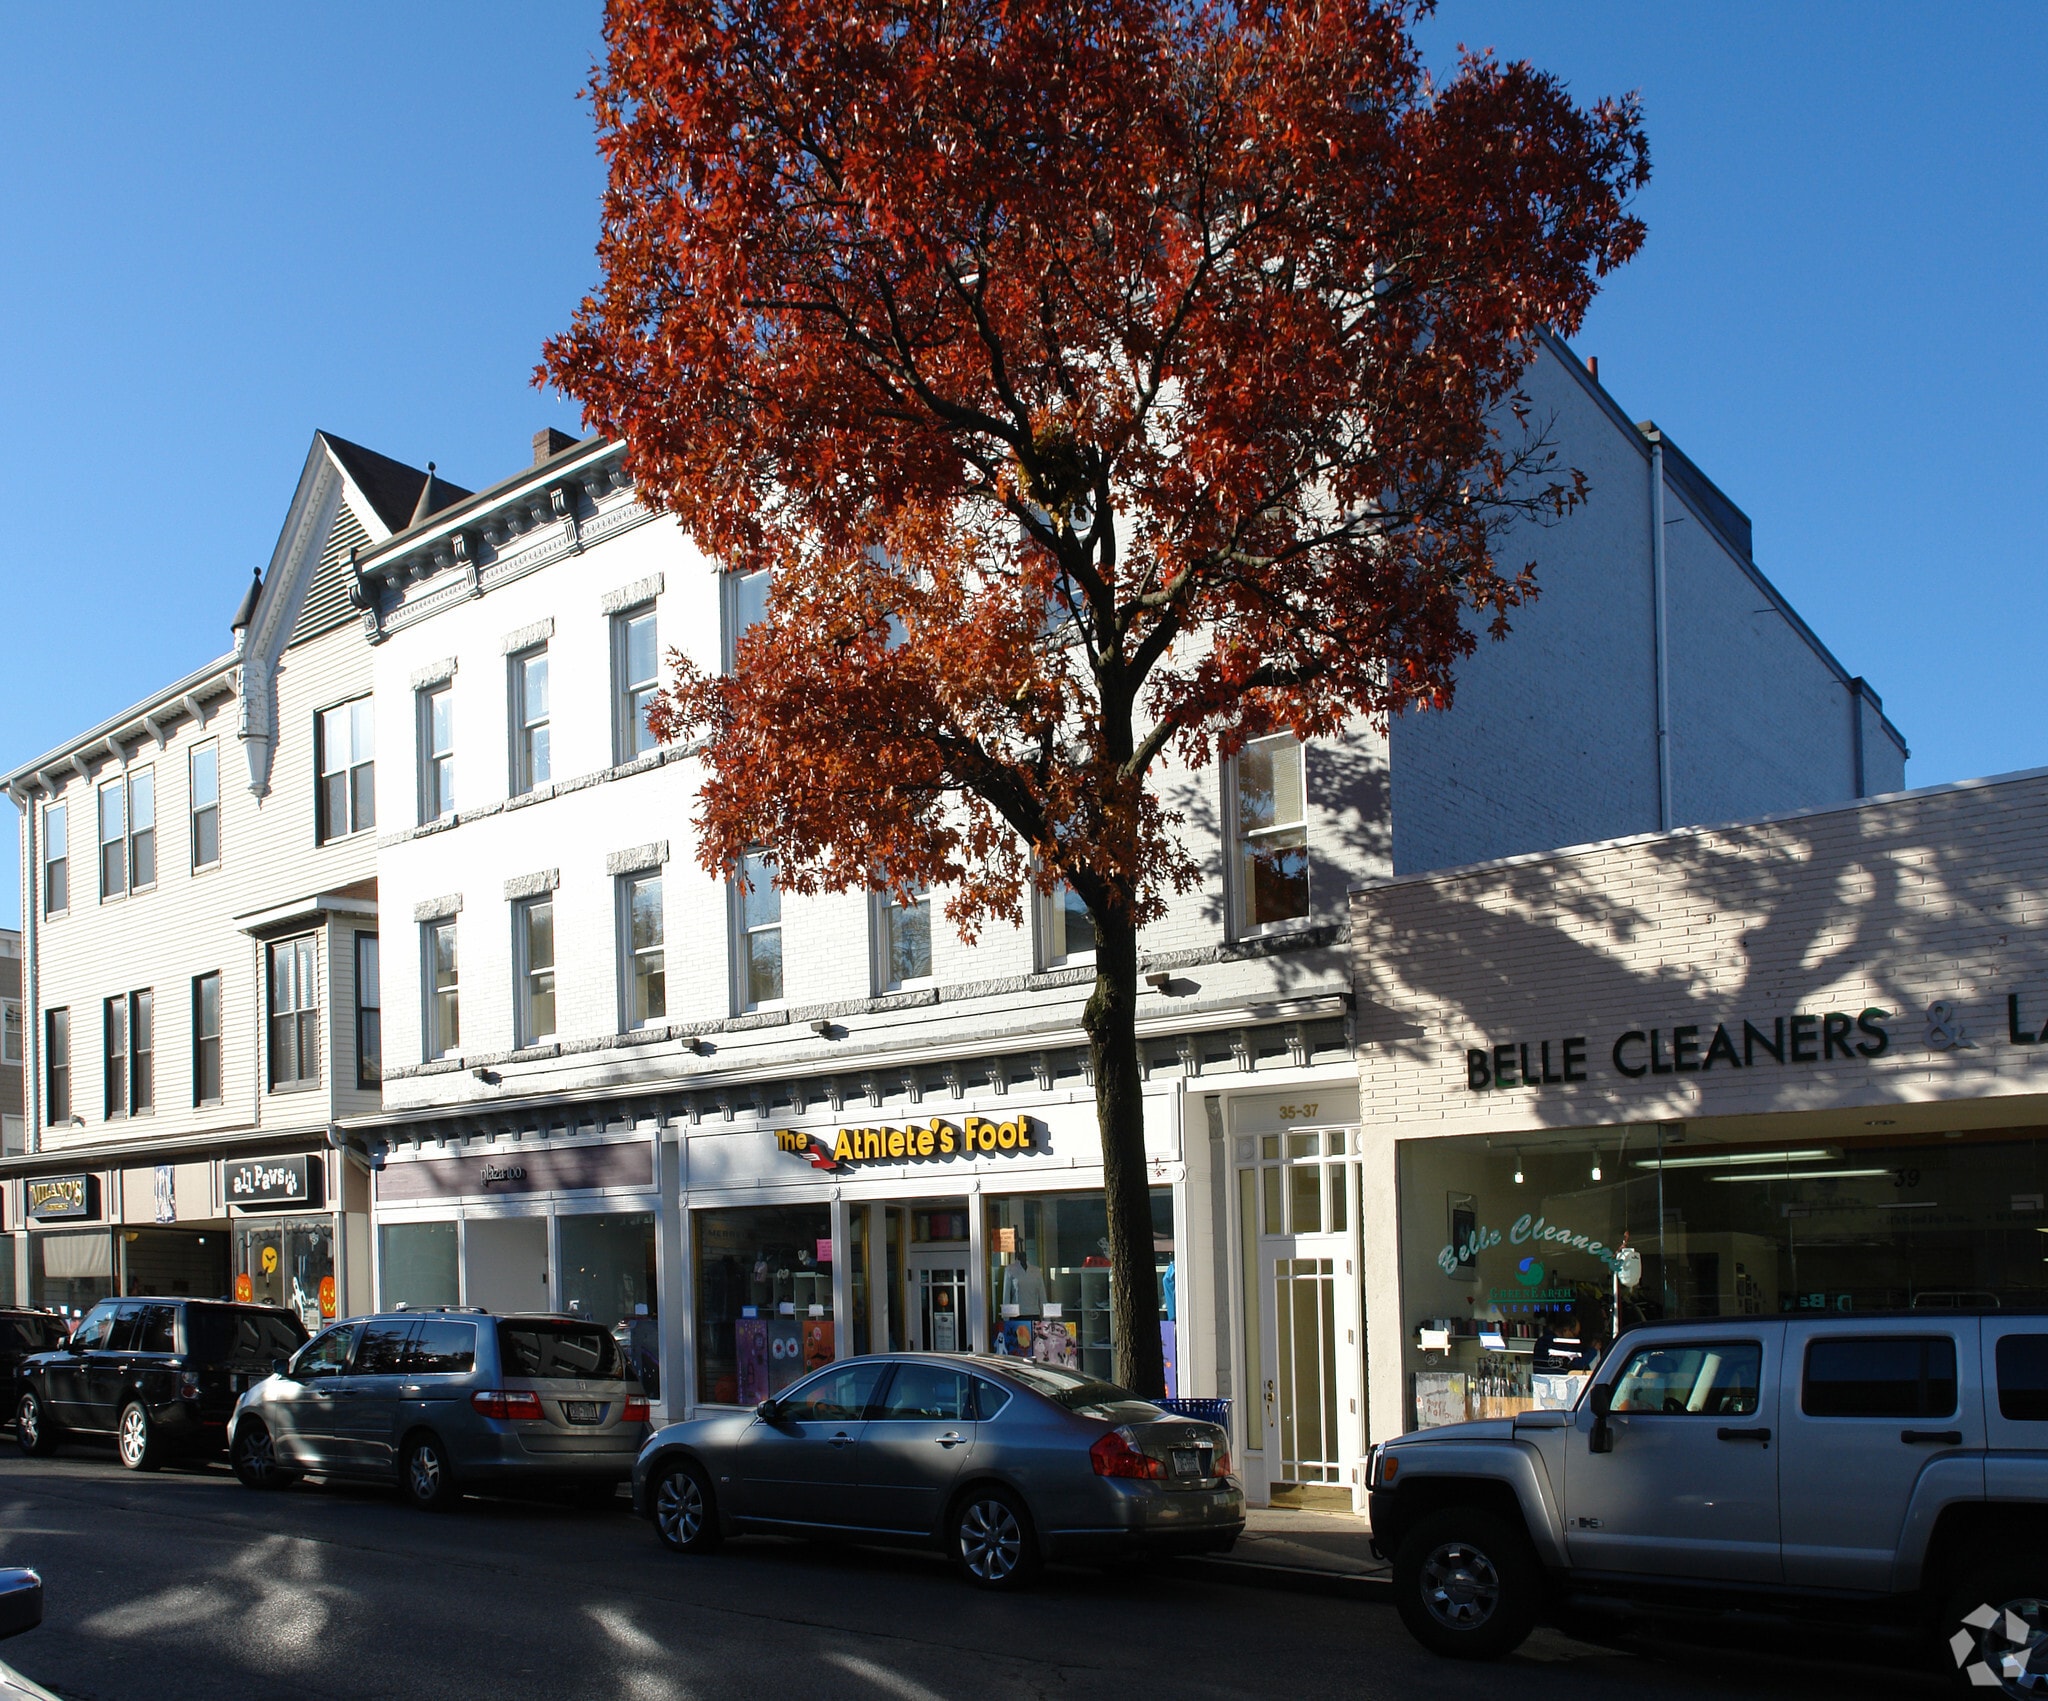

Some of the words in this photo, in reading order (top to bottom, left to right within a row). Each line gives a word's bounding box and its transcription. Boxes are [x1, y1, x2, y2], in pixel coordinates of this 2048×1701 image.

[1467, 1037, 1587, 1090] BELLE
[1612, 1007, 1890, 1079] CLEANERS
[1923, 1000, 1978, 1051] &
[2008, 993, 2048, 1045] L
[1279, 1103, 1319, 1120] 35-37
[774, 1129, 808, 1151] The
[833, 1117, 955, 1162] Athlete's
[965, 1114, 1030, 1152] Foot
[233, 1167, 254, 1194] all
[254, 1164, 285, 1191] Paws
[480, 1163, 505, 1186] plaza
[506, 1166, 522, 1180] too
[1893, 1168, 1921, 1189] 39
[29, 1180, 84, 1210] MILANO'S
[708, 1229, 752, 1240] MERR
[1438, 1225, 1501, 1275] Belle
[1491, 1304, 1572, 1313] CLEANING
